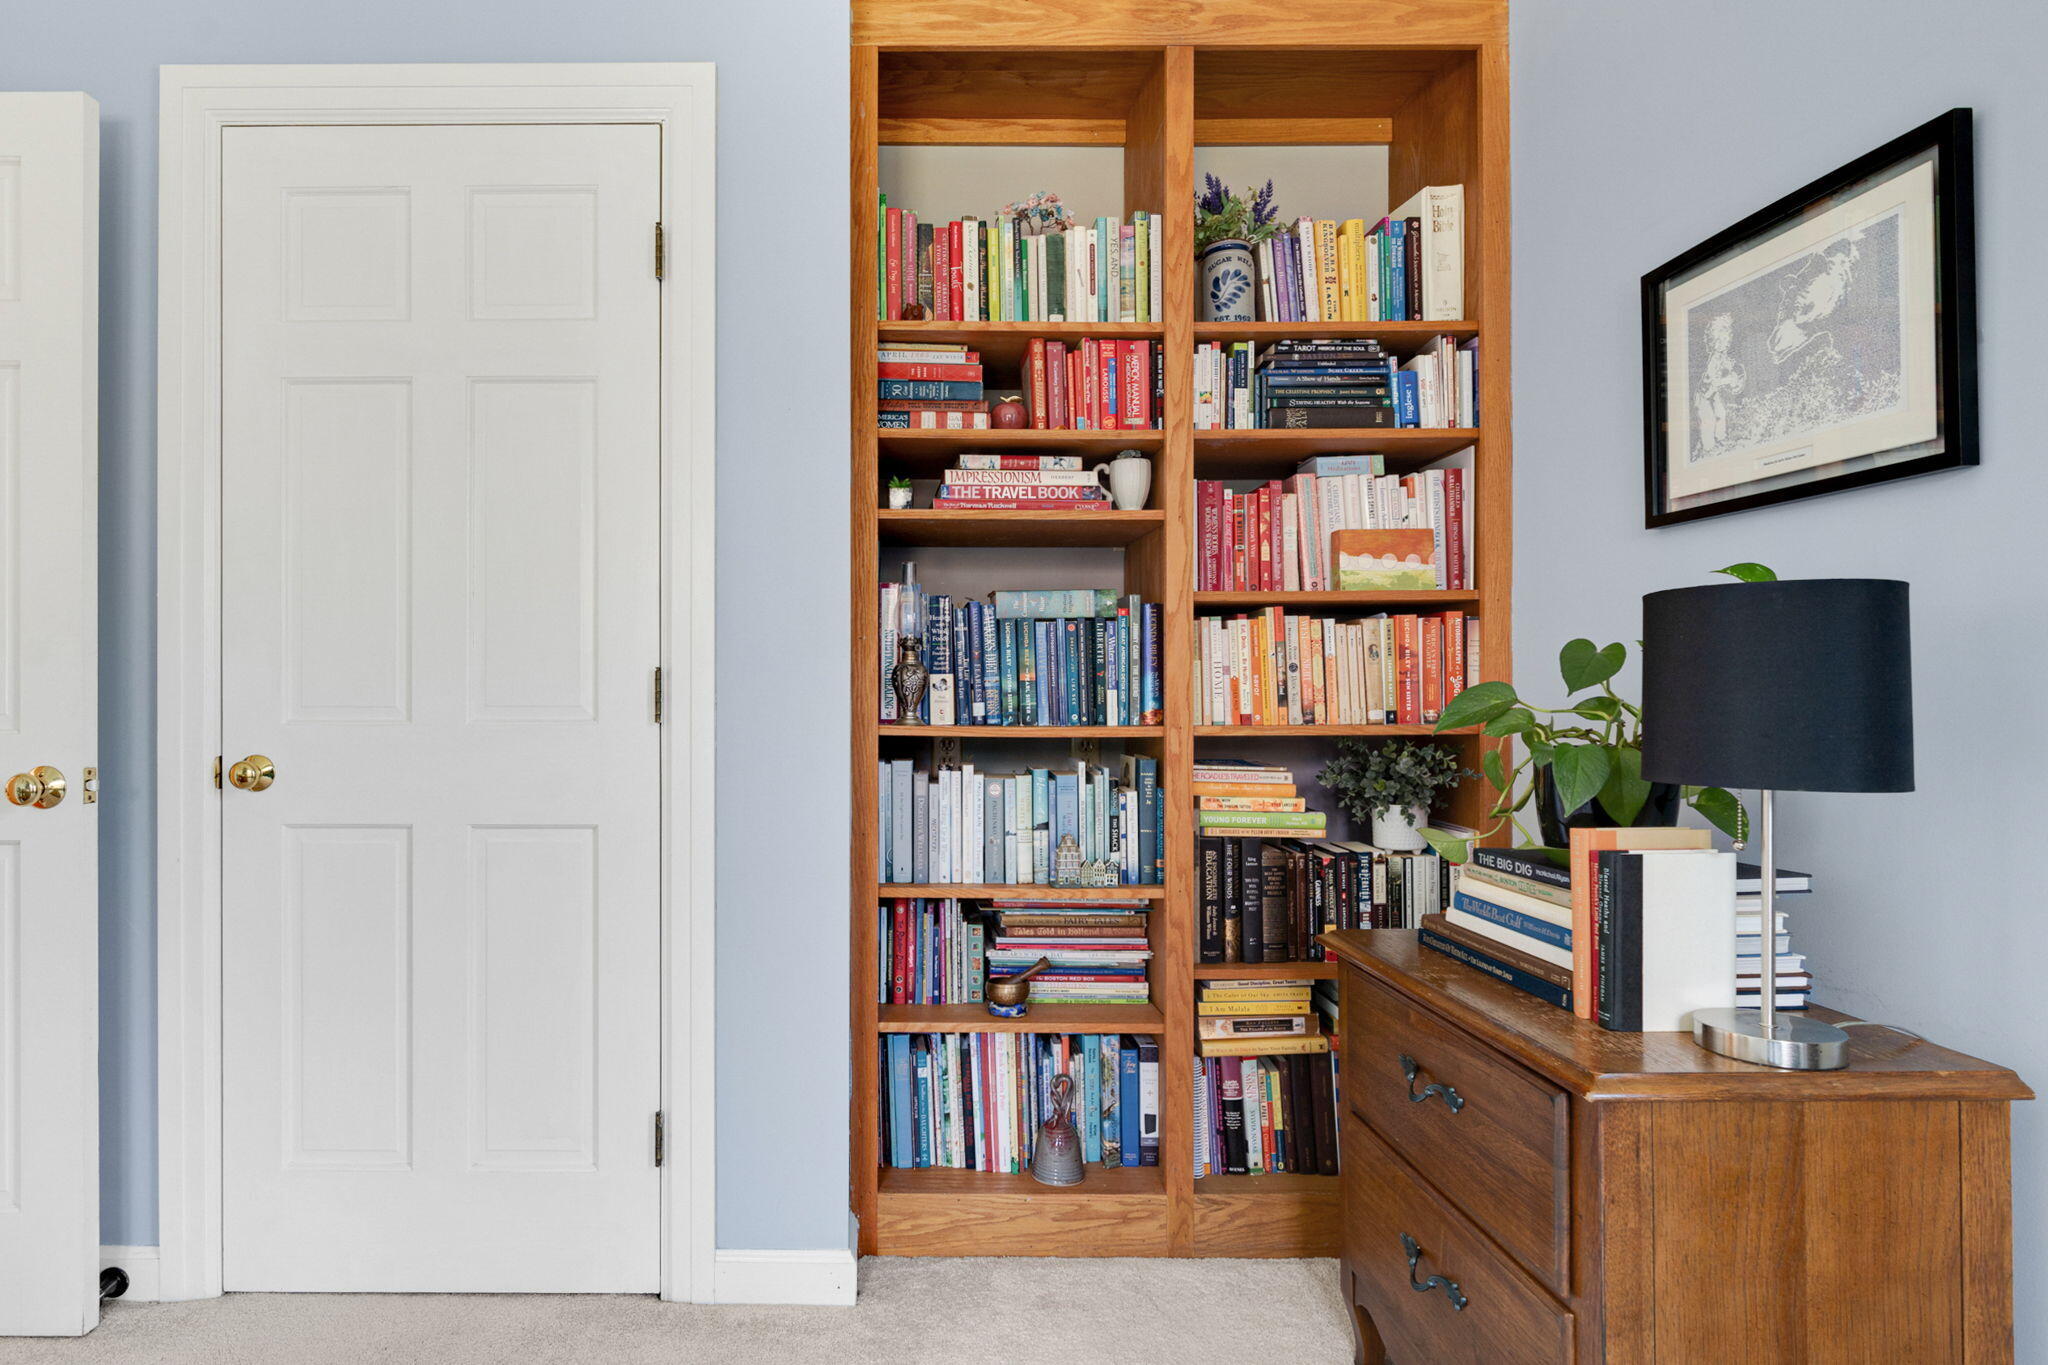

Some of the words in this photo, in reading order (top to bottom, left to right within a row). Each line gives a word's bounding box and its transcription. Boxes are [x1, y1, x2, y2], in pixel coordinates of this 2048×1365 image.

[1294, 344, 1316, 352] TAROT
[1131, 355, 1139, 381] MERCK
[1131, 384, 1140, 417] MANUAL
[949, 470, 1042, 484] IMPRESSIONISM
[954, 485, 981, 499] THE
[982, 485, 1037, 499] TRAVEL
[1038, 485, 1079, 499] BOOK
[885, 629, 894, 676] NUTRITIONAL
[1096, 623, 1105, 664] LIBERTIE
[1108, 636, 1116, 663] Water
[885, 677, 895, 710] HEALING
[974, 663, 982, 702] FEARLESS
[1203, 816, 1230, 825] YOUNG
[1231, 816, 1267, 825] FOREVER
[1478, 853, 1496, 868] THE
[1496, 857, 1514, 872] BIG
[1515, 862, 1533, 877] DIG
[1603, 867, 1611, 892] Blasted
[1603, 894, 1611, 919] Heaths
[1014, 927, 1035, 936] Tales
[1037, 927, 1055, 936] Told
[1057, 927, 1066, 935] in
[1064, 917, 1089, 925] FAIRY
[1093, 917, 1120, 925] TALES
[1603, 920, 1611, 934] and
[921, 1113, 929, 1151] DAUGHTERS
